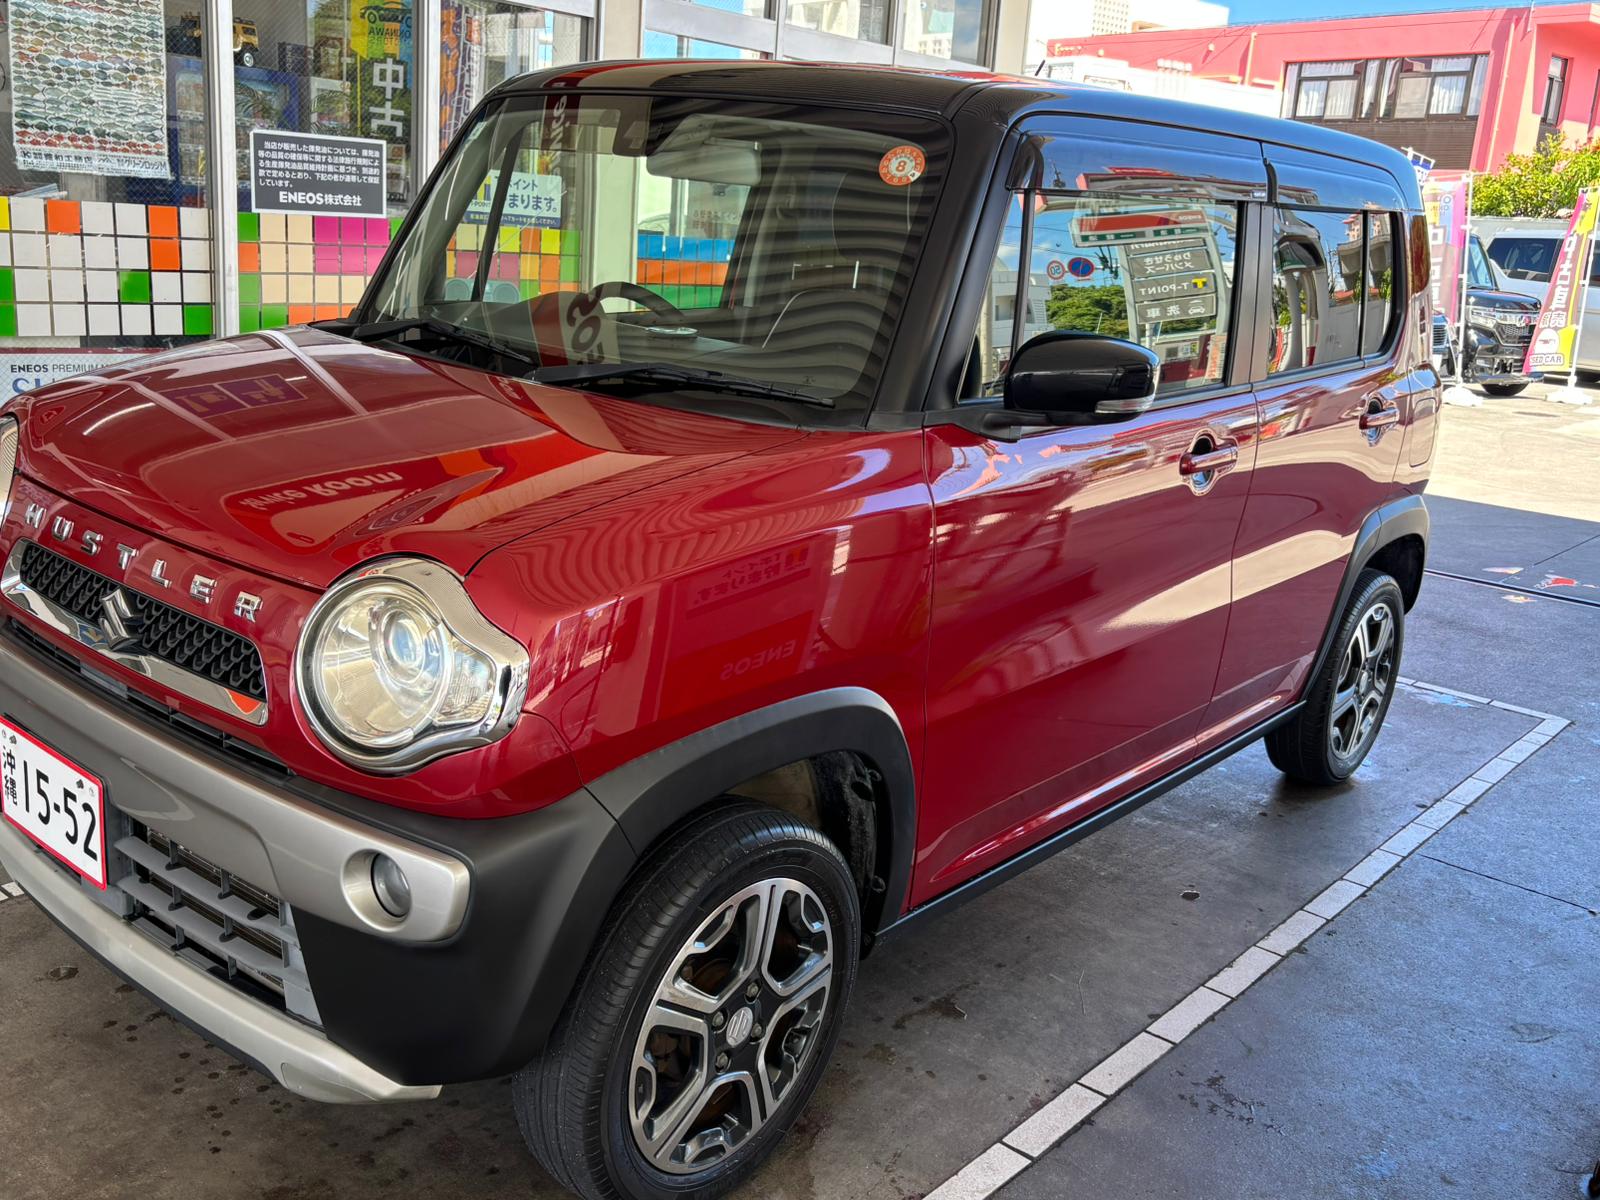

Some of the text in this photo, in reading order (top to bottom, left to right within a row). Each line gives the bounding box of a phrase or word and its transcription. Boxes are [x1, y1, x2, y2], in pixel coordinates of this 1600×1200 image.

[279, 191, 362, 206] ENEOS株式会社
[508, 194, 557, 212] まります。
[1545, 354, 1562, 364] CAR
[11, 364, 48, 373] ENEOS
[25, 502, 264, 623] HUSTLER
[3, 745, 17, 806] 沖縄
[23, 760, 98, 861] 15-52
